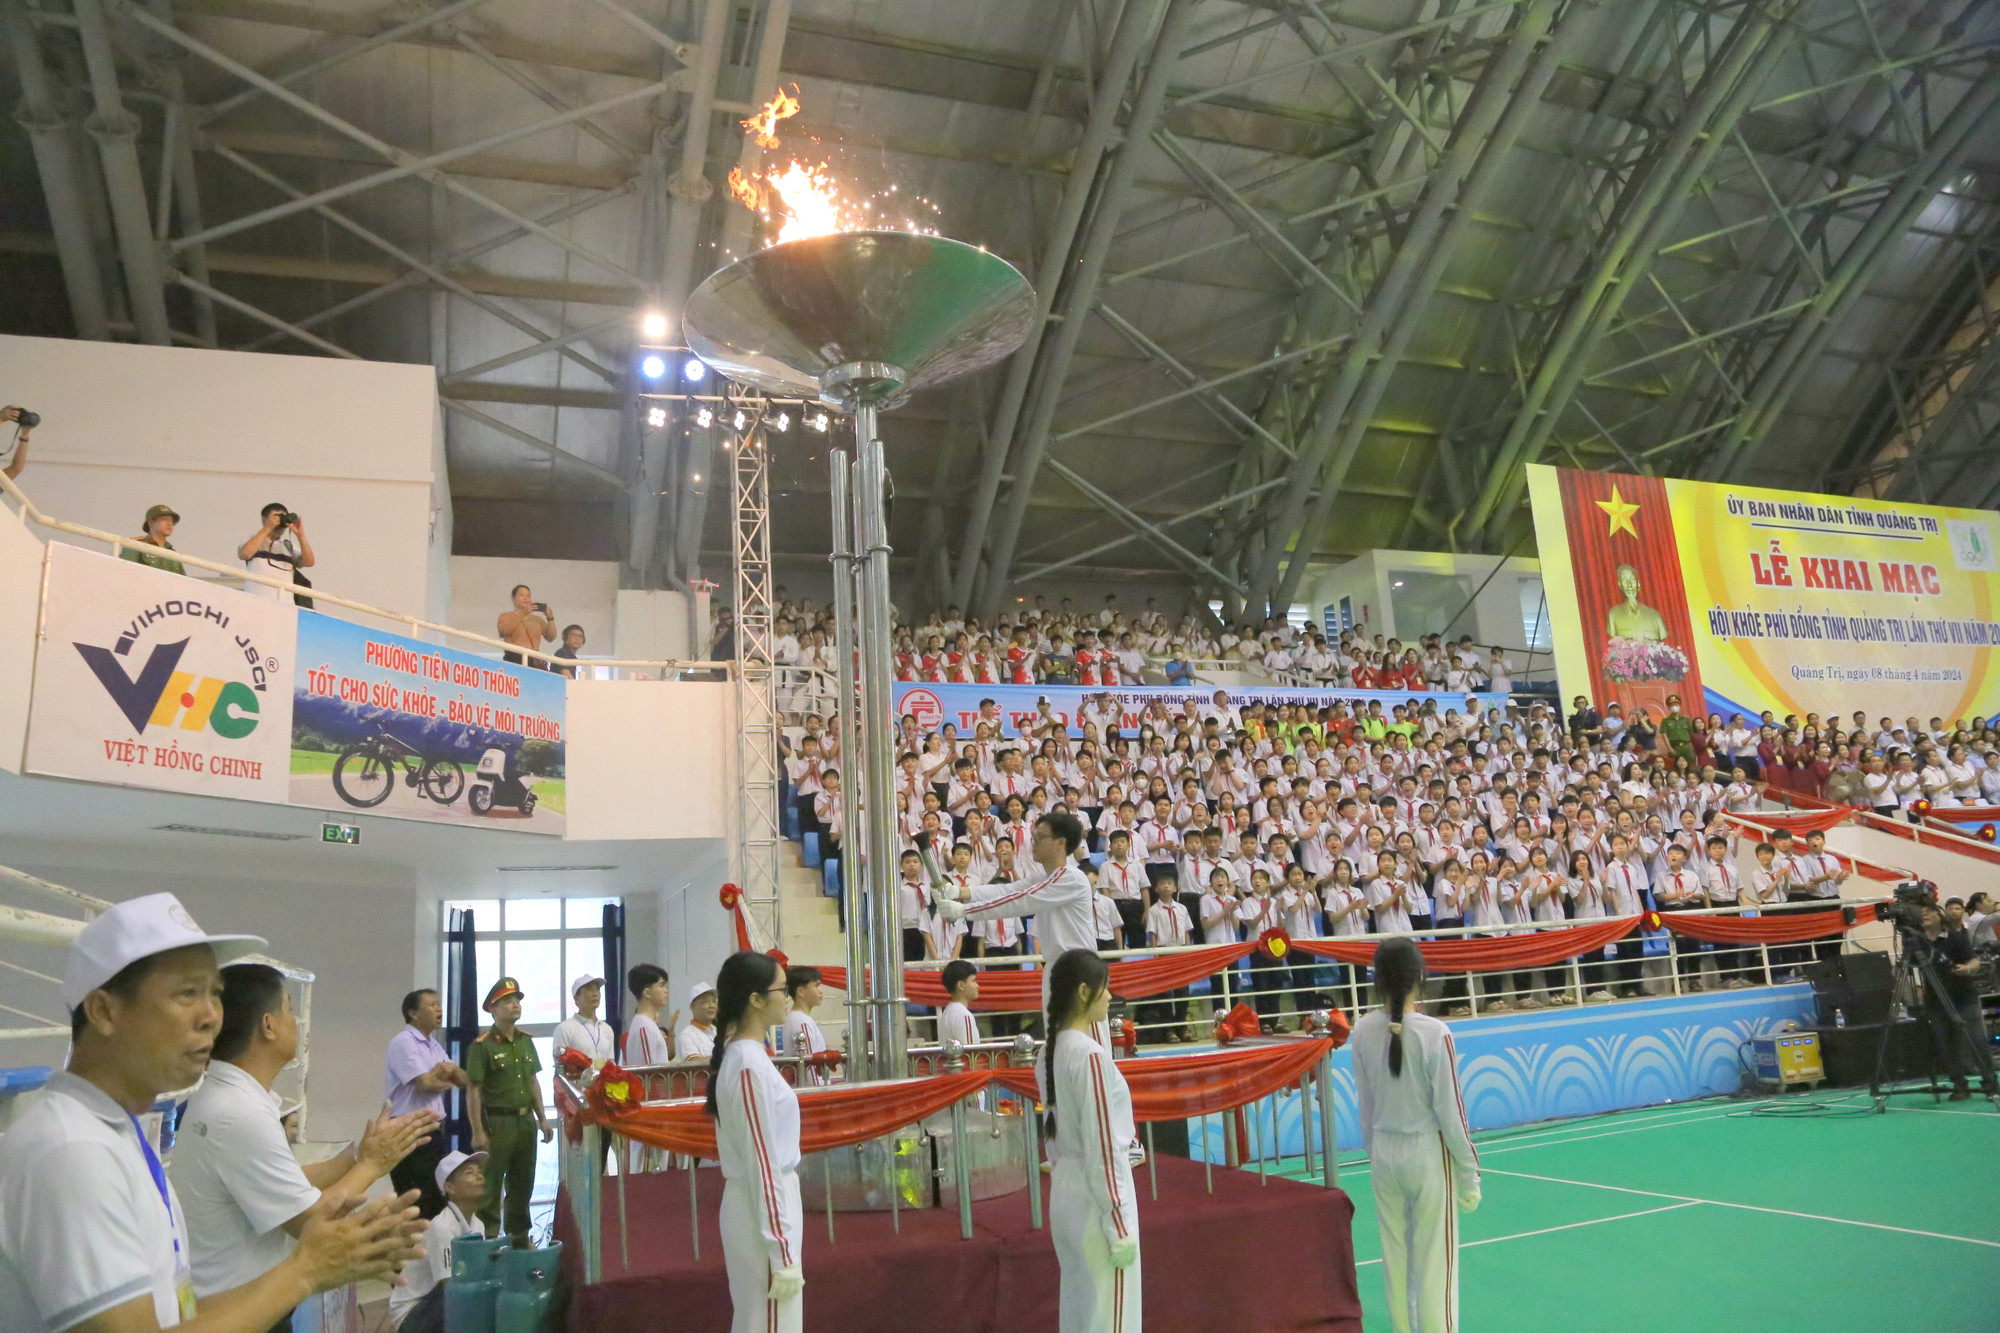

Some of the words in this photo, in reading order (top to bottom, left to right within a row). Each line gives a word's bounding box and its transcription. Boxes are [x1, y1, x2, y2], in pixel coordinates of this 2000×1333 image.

[1727, 494, 1744, 515] ỦY
[1749, 501, 1776, 518] BAN
[1779, 502, 1815, 522] NHÂN
[1817, 506, 1844, 524] DÂN
[1845, 506, 1874, 527] TỈNH
[1877, 510, 1917, 531] QUẢNG
[1918, 517, 1939, 535] TRỊ
[1750, 540, 1793, 587] LỄ
[1800, 556, 1873, 592] KHAI
[1878, 562, 1941, 602] MẠC
[121, 601, 230, 639] VIHOCHI
[1708, 605, 1731, 642] HỘI
[1731, 604, 1764, 637] KHỎE
[1764, 608, 1789, 638] PHÙ
[1821, 607, 1849, 640] TỈNH
[1849, 610, 1887, 643] QUẢNG
[1886, 619, 1907, 648] TRỊ
[1927, 617, 1948, 643] THỨ
[1948, 622, 1964, 644] VII
[1963, 618, 1989, 645] NĂM
[365, 641, 418, 675] PHƯƠNG
[421, 652, 450, 684] TIỆN
[453, 663, 479, 689] GIAO
[482, 668, 520, 698] THÔNG
[1791, 664, 1824, 681] Quảng
[1847, 669, 1870, 682] ngày
[1884, 668, 1912, 682] tháng
[1913, 669, 1919, 679] 4
[1921, 670, 1941, 681] năm
[1942, 669, 1963, 681] 2024
[307, 664, 336, 697] TỐT
[340, 677, 369, 704] CHO
[372, 679, 399, 711] SỨC
[402, 686, 437, 718] KHỎE
[448, 694, 473, 726] BẢO
[476, 702, 491, 734] VỆ
[494, 707, 516, 734] MÔI
[518, 714, 561, 742] TRƯỜNG
[1009, 712, 1069, 729] THO
[104, 738, 148, 767] VIỆT
[154, 739, 204, 772] HỒNG
[210, 756, 262, 780] CHINH
[326, 827, 356, 841] EXIT
